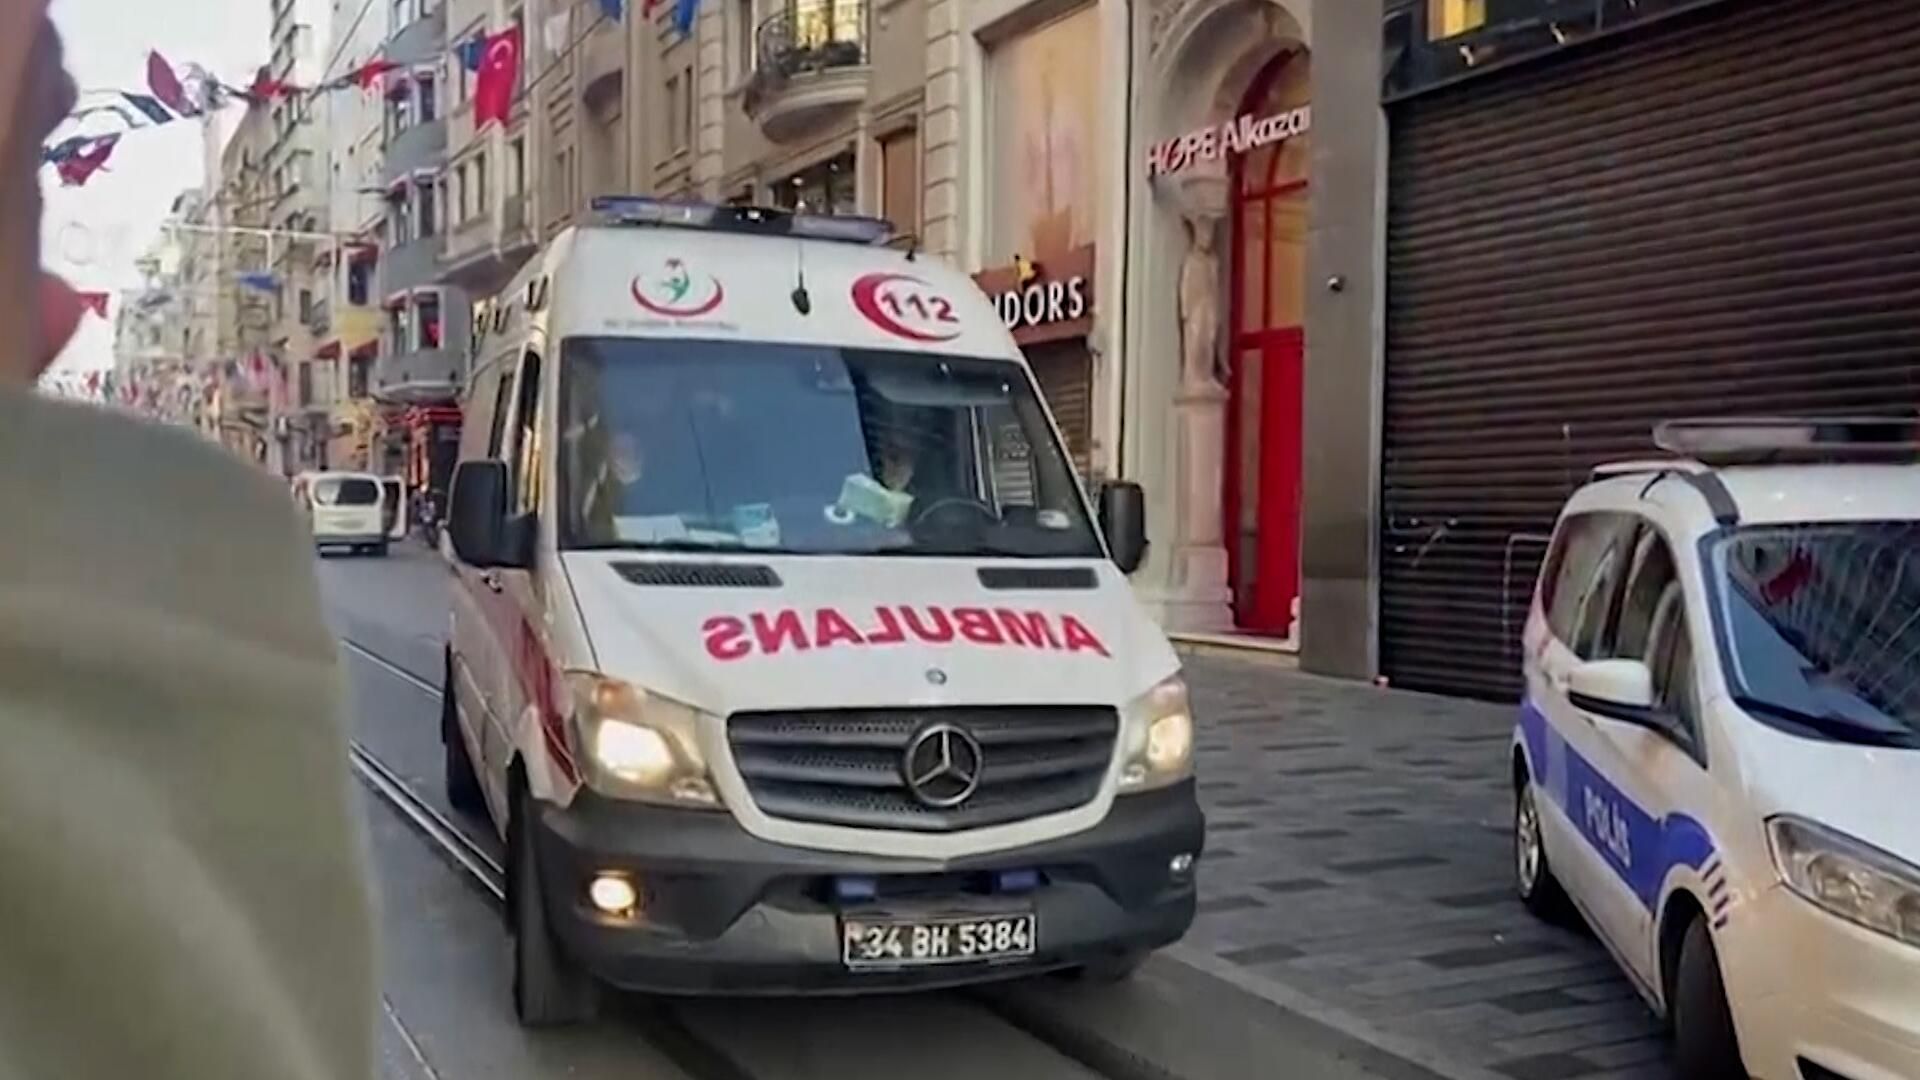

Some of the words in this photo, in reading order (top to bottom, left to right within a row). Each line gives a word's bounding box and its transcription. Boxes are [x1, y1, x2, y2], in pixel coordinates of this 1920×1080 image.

[1147, 126, 1217, 175] HOPE
[881, 292, 960, 323] 112
[863, 926, 903, 958] 34
[911, 926, 949, 956] BH
[959, 918, 1028, 955] 5384
